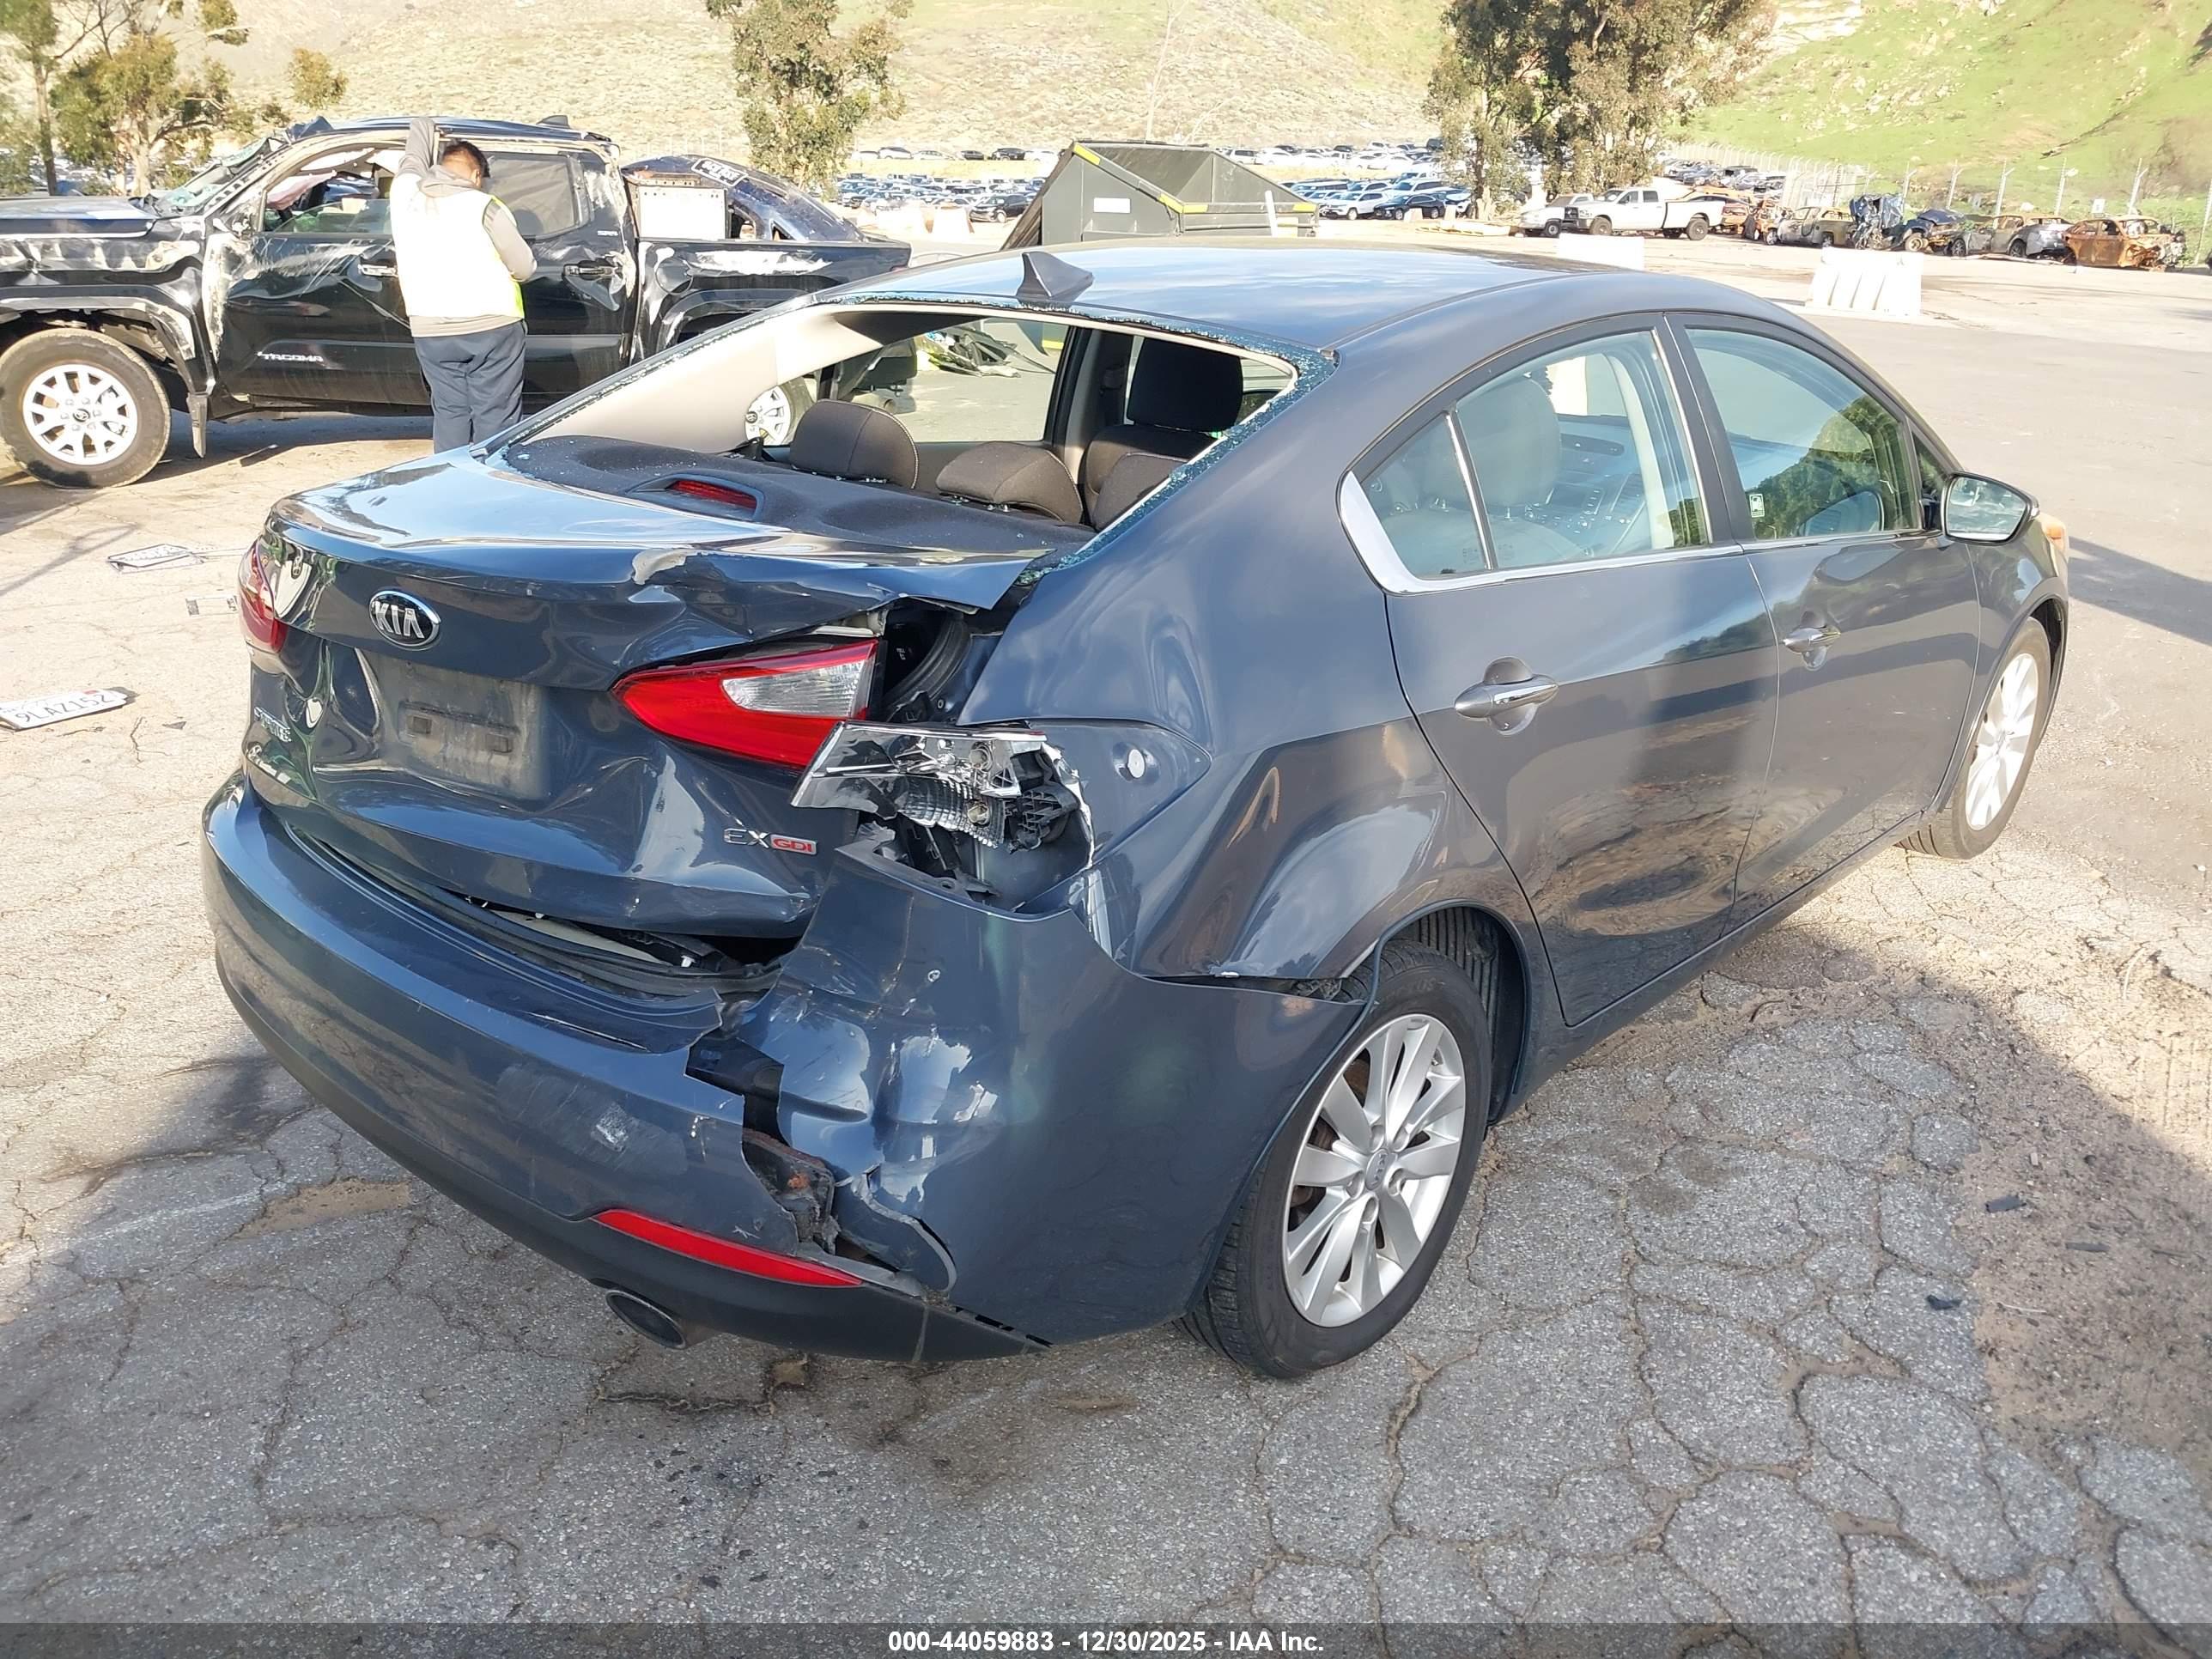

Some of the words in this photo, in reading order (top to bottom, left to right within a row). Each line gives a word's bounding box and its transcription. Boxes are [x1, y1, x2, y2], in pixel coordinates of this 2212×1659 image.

[374, 601, 425, 639] KIA
[15, 694, 115, 723] 9LAZ152
[724, 828, 769, 848] EX
[772, 837, 814, 853] GDI
